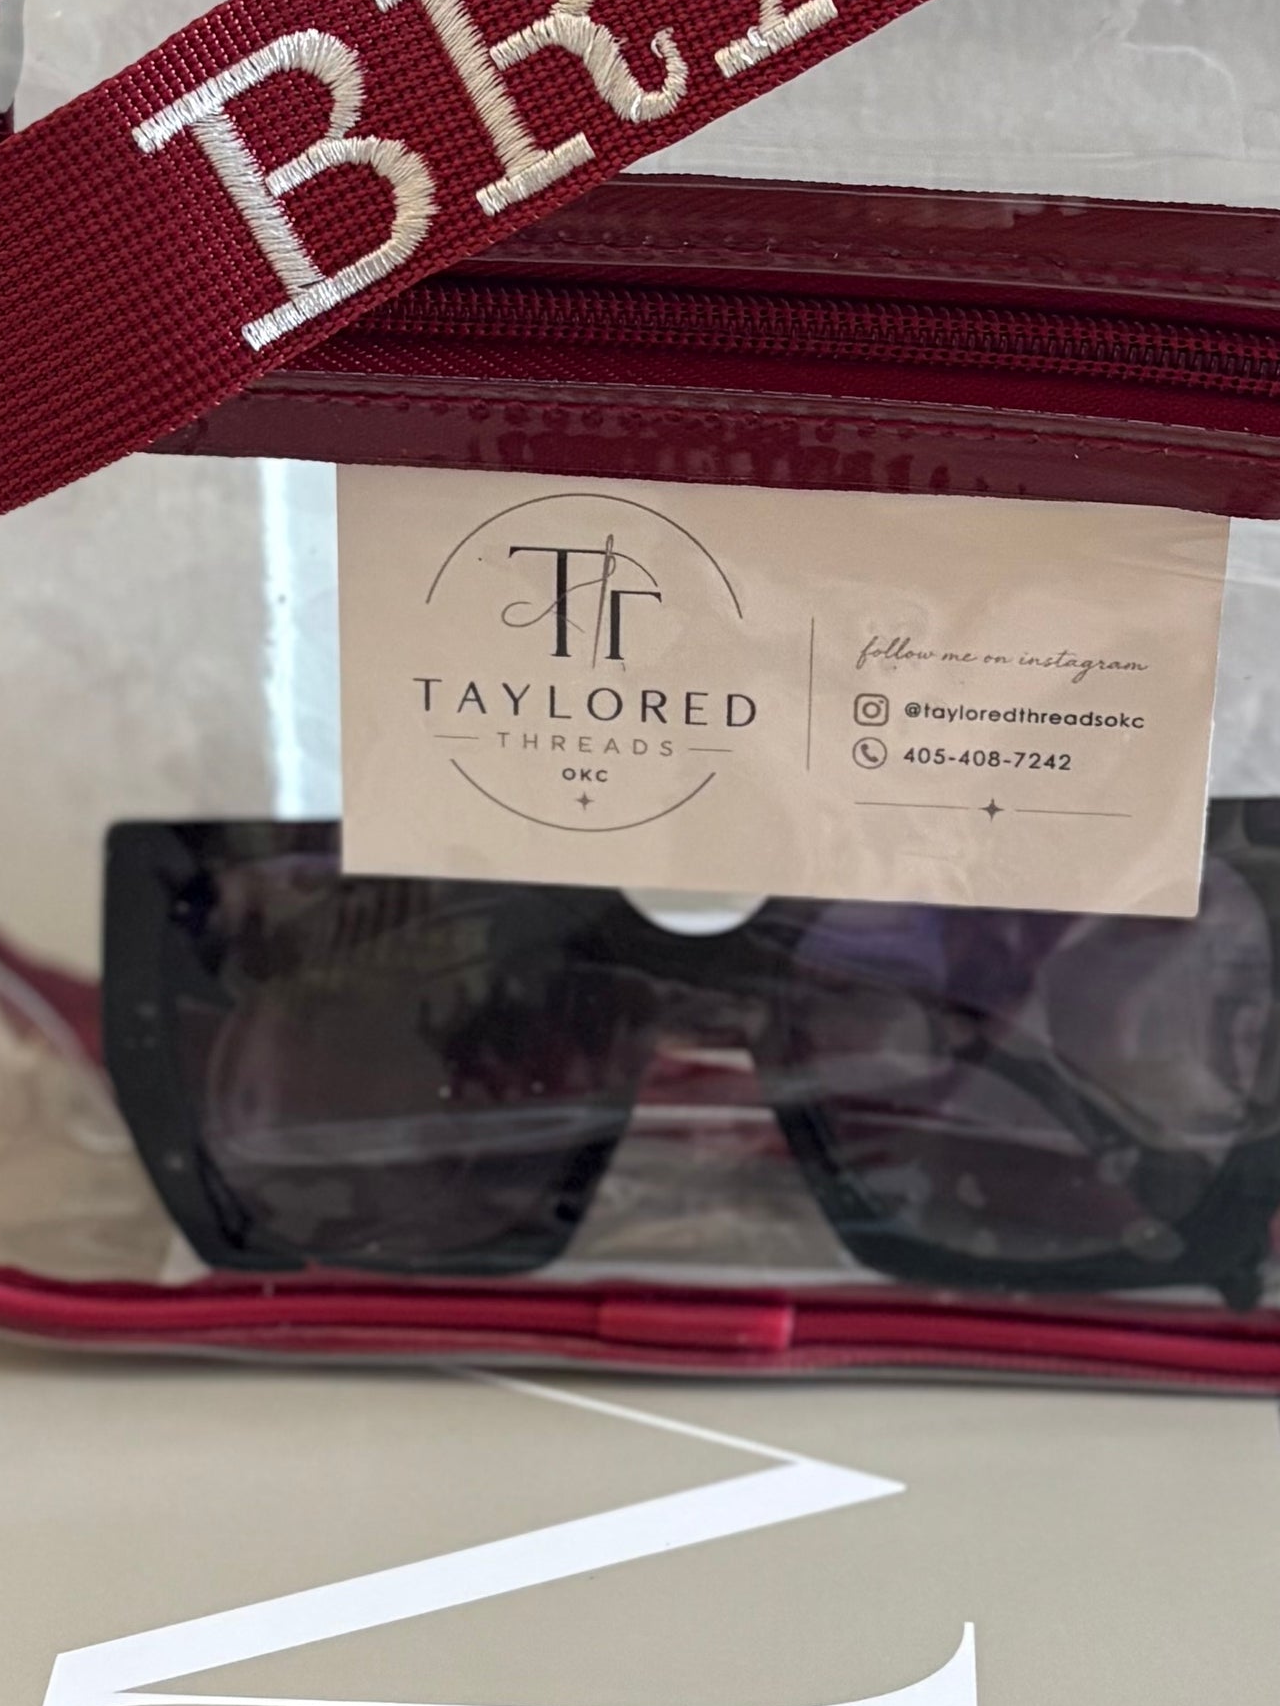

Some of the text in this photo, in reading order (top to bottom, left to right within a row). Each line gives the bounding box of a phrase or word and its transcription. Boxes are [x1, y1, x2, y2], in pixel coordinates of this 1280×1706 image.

[855, 635, 1149, 684] follow me on instagram
[412, 677, 757, 728] TAYLORED
[903, 702, 1146, 730] @tayloredthreadsokc
[496, 731, 674, 757] THREADS
[903, 746, 1072, 771] 405-408-7242
[561, 767, 609, 783] OKC
